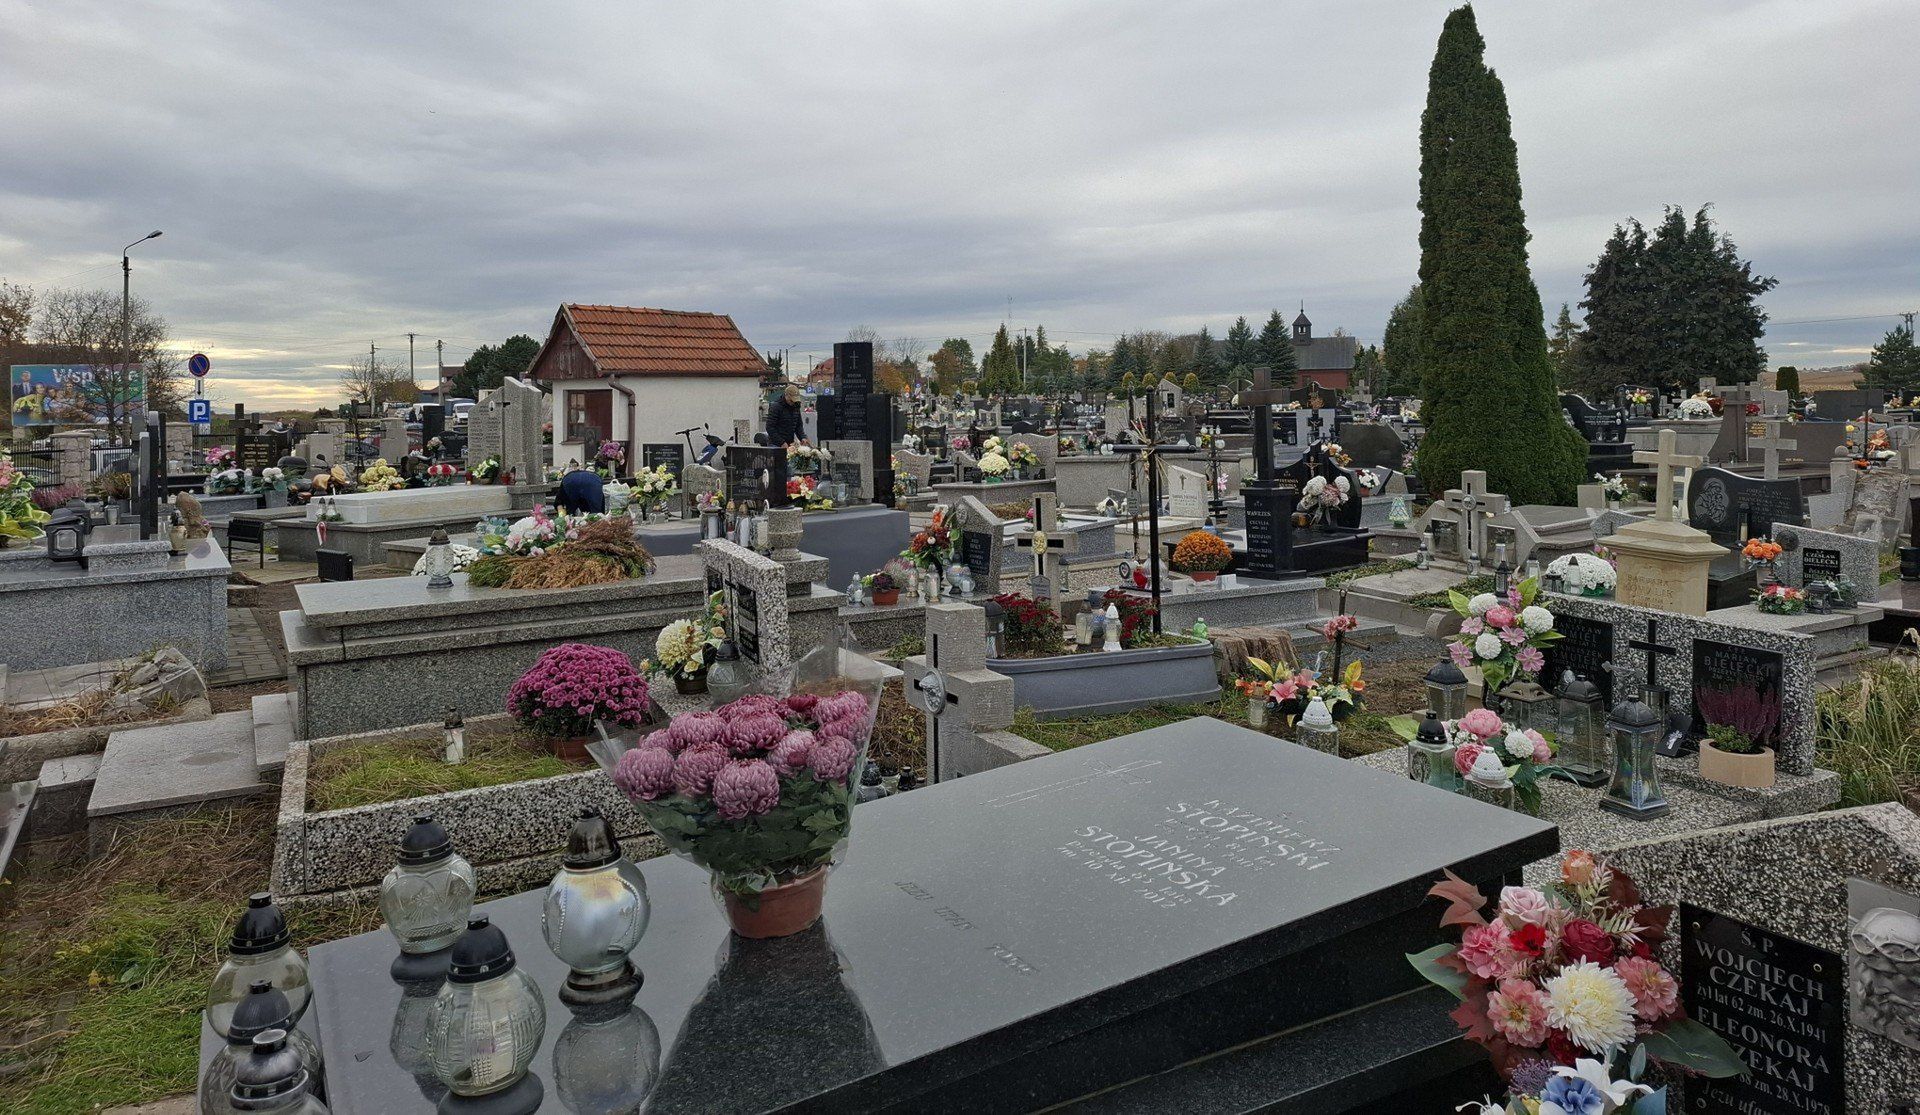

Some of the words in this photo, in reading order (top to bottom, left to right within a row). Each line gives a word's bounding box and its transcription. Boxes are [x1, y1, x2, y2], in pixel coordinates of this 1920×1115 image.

[193, 403, 206, 420] P
[1134, 835, 1227, 876] JANINA
[1695, 938, 1824, 1001] WOJCIECH
[1709, 965, 1810, 1017] CZEKAJ
[1715, 988, 1729, 1005] lat
[1731, 994, 1744, 1011] 62
[1747, 1004, 1767, 1021] zm.
[1697, 1005, 1830, 1075] ELEONORA
[1725, 1039, 1815, 1093] ZEKAJ
[1702, 1080, 1734, 1107] Jezu
